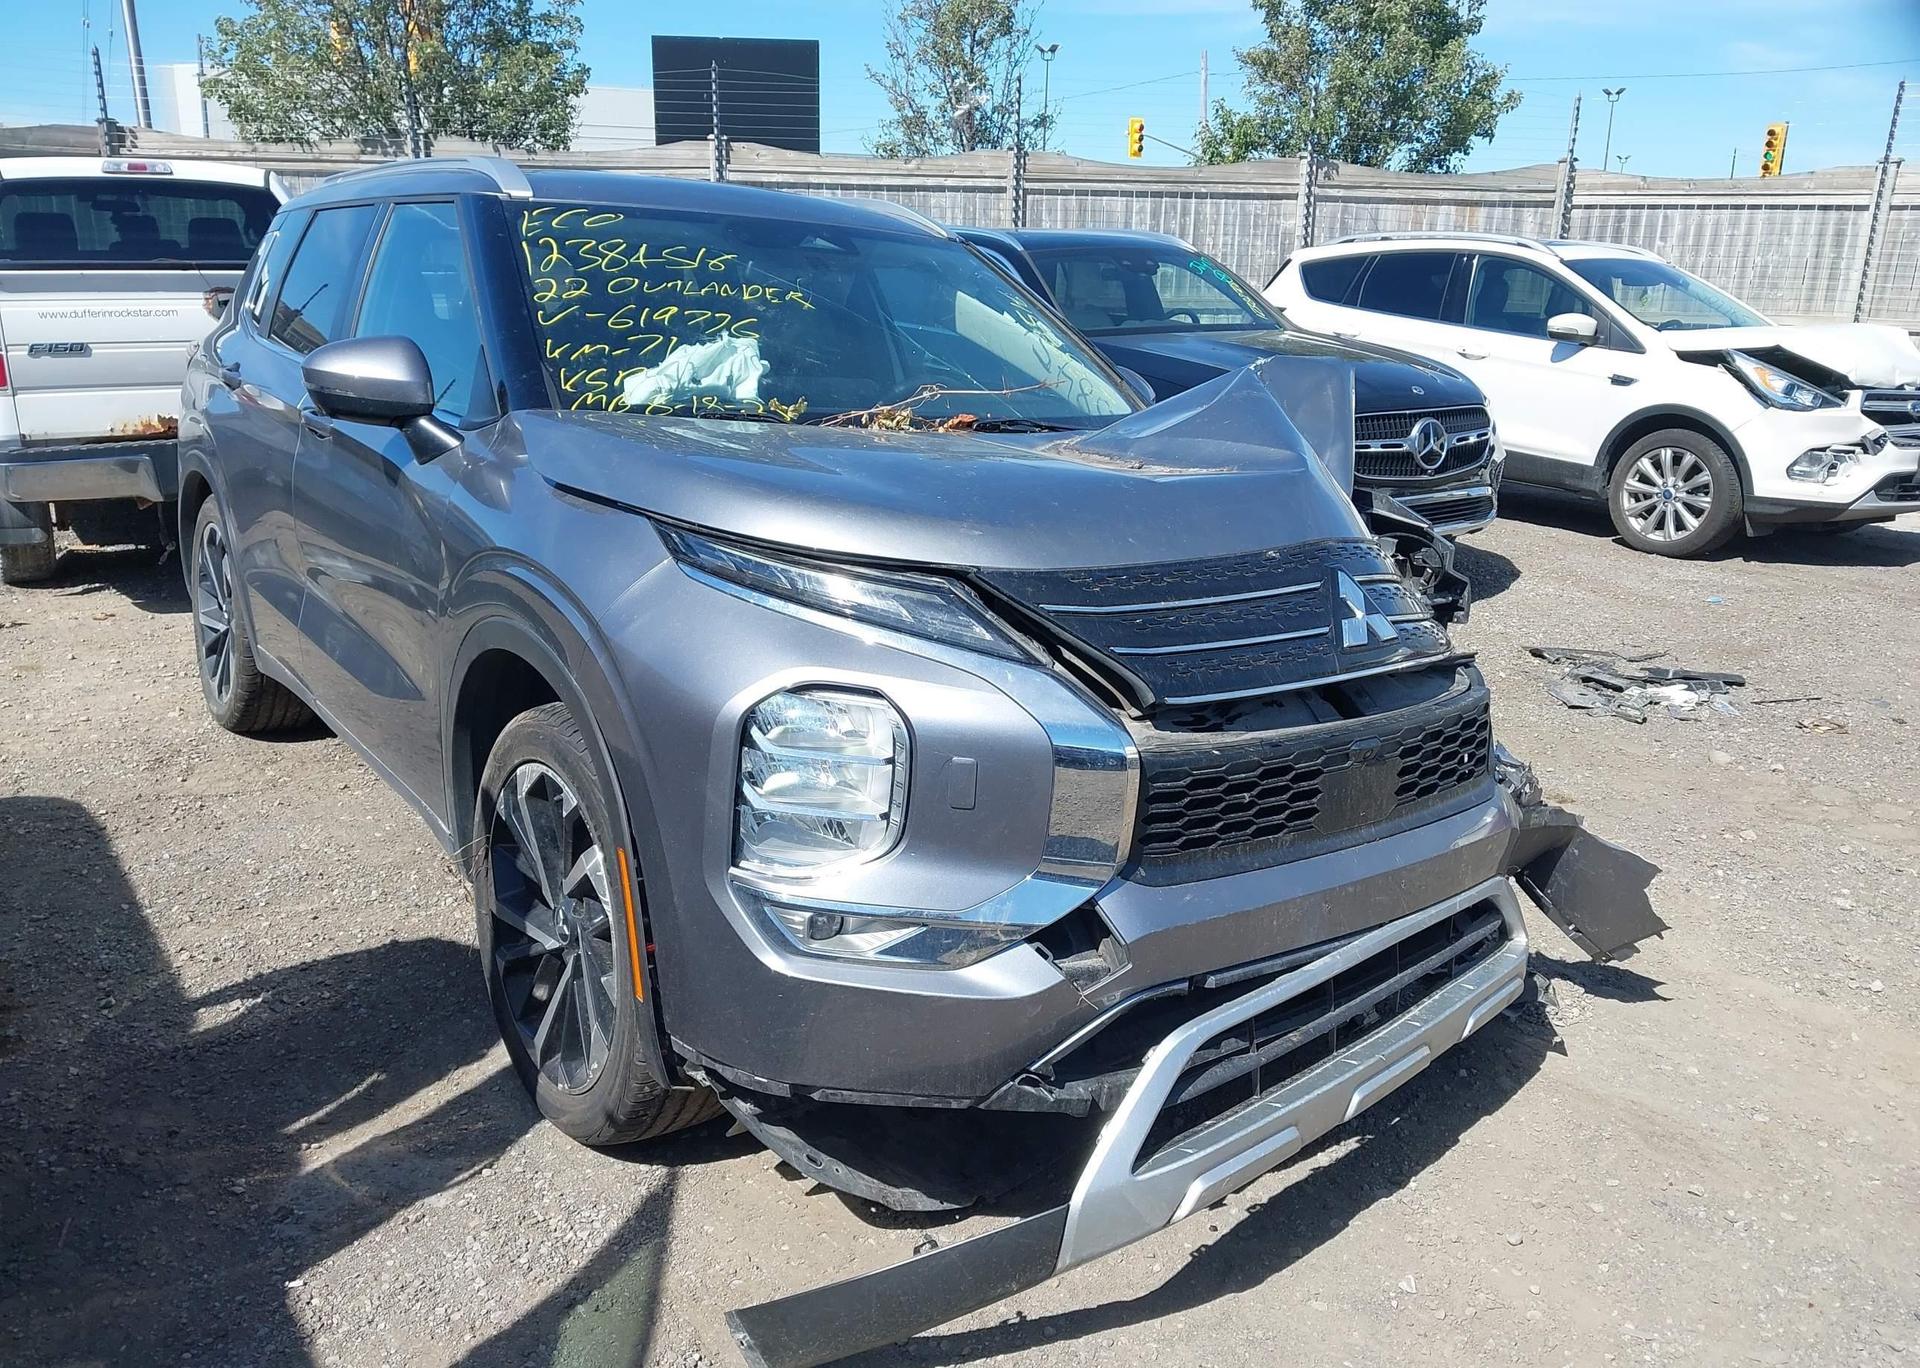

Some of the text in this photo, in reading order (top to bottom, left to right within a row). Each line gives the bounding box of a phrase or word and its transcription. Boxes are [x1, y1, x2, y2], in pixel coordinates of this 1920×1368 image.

[522, 206, 625, 237] ECO
[533, 276, 817, 310] 22 OUTLANDER
[37, 308, 179, 320] www.dufferinrockstar.com
